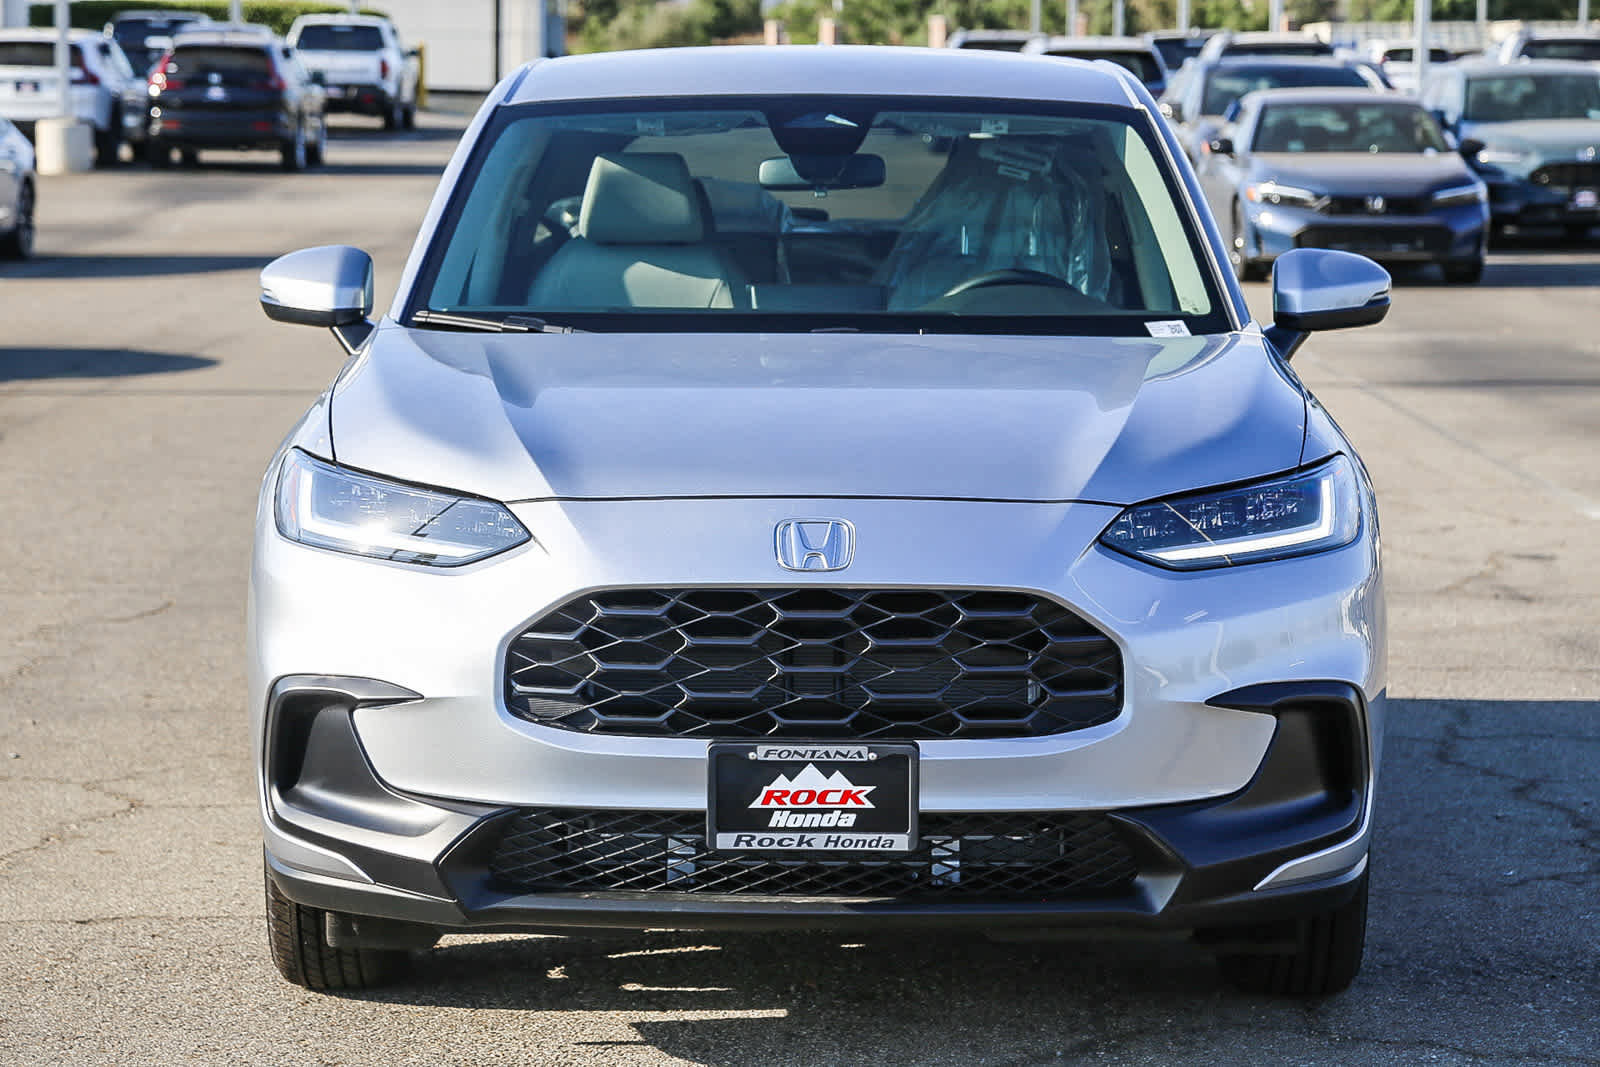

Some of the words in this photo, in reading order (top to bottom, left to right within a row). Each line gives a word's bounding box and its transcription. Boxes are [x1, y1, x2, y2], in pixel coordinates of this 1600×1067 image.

[763, 749, 865, 760] FONTANA
[760, 789, 867, 806] ROCK
[768, 810, 857, 828] Honda
[733, 834, 817, 848] Rock
[823, 835, 895, 849] Honda
